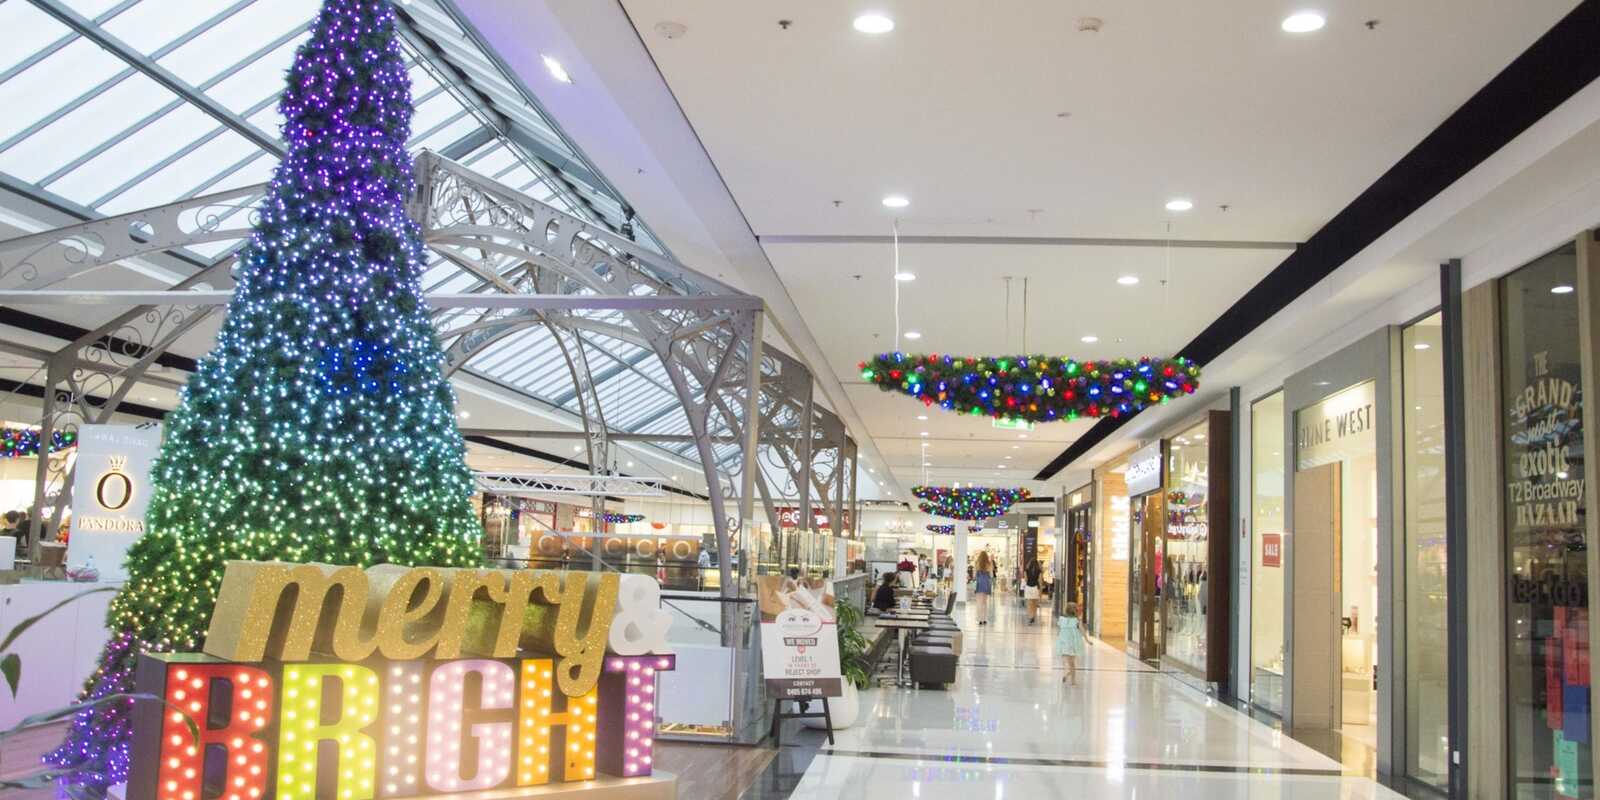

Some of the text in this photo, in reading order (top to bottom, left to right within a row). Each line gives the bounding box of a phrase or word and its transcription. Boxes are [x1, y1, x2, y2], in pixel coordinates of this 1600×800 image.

[1515, 378, 1572, 418] GRAND
[1336, 404, 1372, 438] WEST
[1519, 438, 1570, 477] exotic
[1509, 478, 1584, 502] T2 Broadway
[78, 517, 144, 532] PANDORA
[1516, 500, 1578, 527] BAZAAR
[1264, 543, 1279, 557] SALE
[235, 560, 621, 697] merry
[155, 654, 675, 800] BRIGHT
